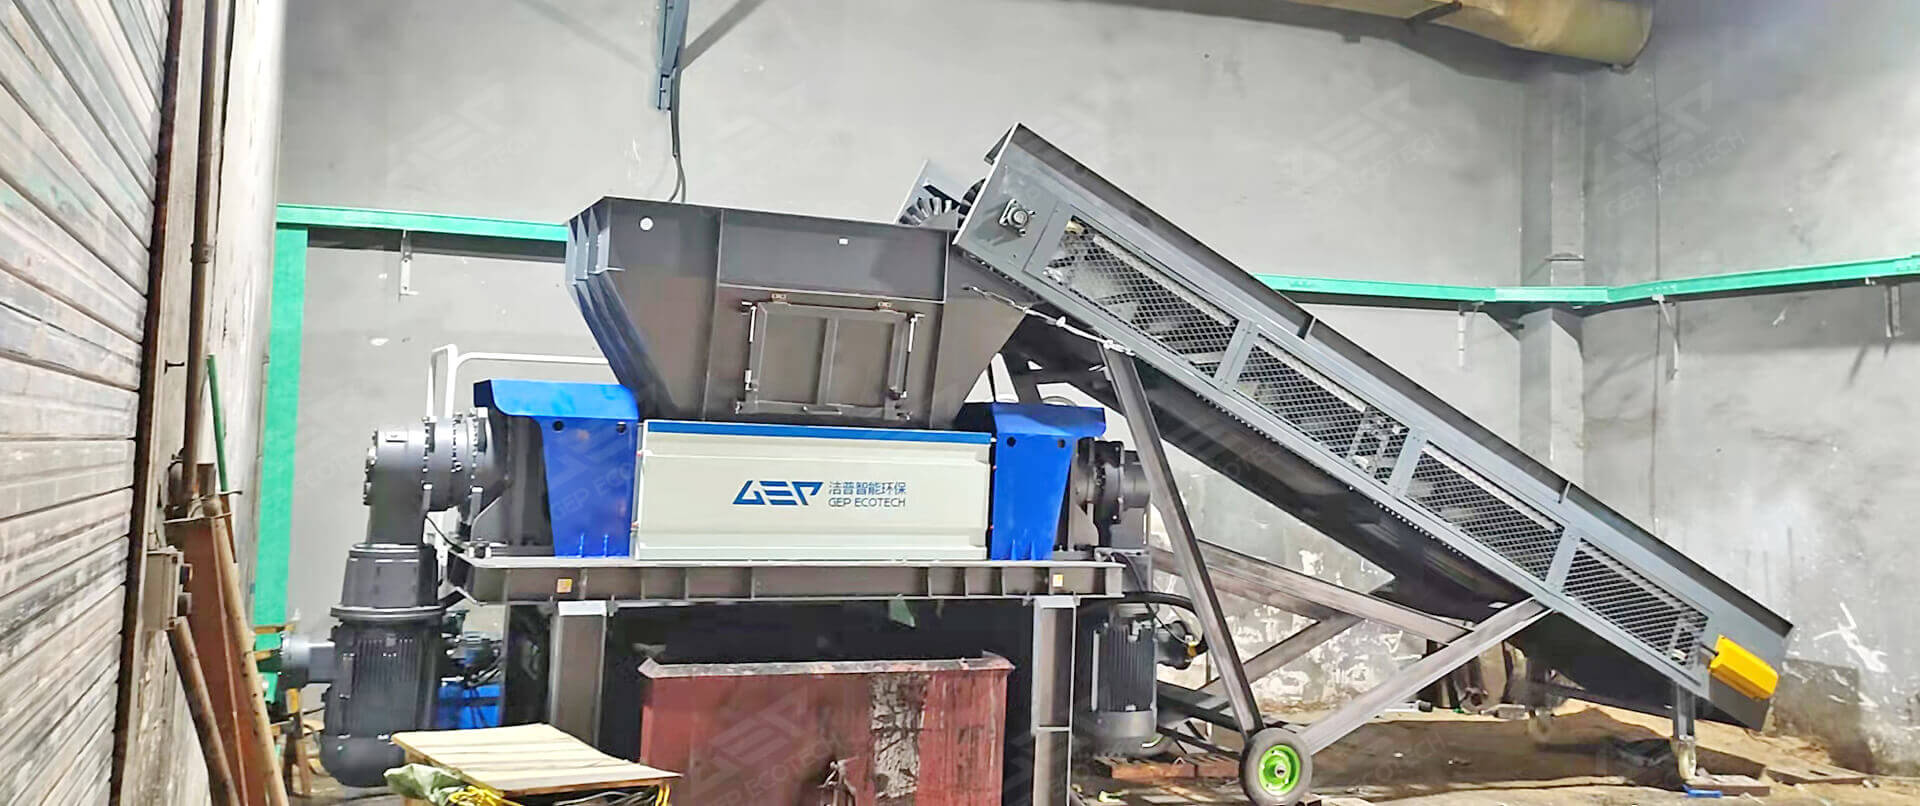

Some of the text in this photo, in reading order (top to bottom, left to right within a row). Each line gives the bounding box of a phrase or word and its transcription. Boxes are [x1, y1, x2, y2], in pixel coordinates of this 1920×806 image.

[732, 480, 824, 505] GEP
[828, 481, 907, 496] 洁普智能环保
[828, 498, 906, 507] GEP ECOTECH
